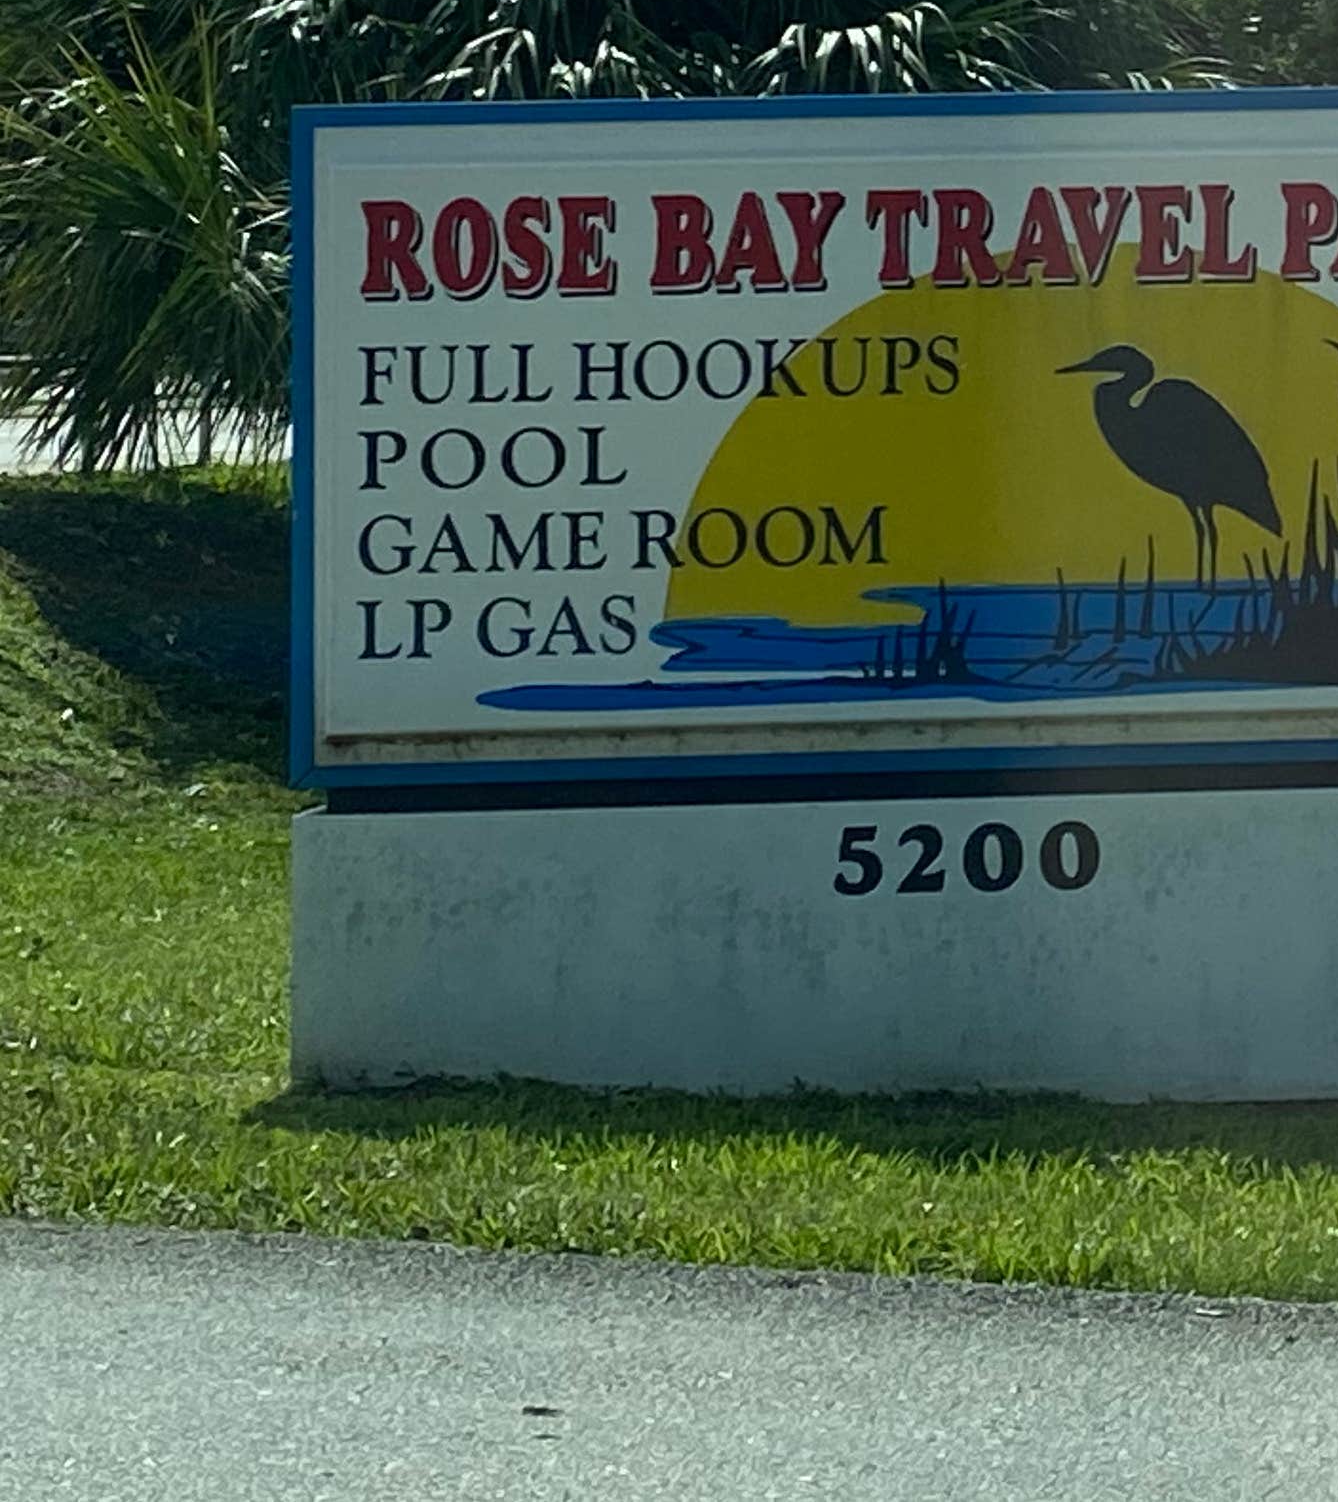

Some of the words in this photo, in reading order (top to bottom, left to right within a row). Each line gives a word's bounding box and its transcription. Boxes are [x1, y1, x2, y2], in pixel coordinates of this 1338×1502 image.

[360, 195, 616, 301] ROSE
[650, 191, 845, 296] BAY
[866, 184, 1257, 288] TRAVEL
[357, 343, 553, 406] FULL
[573, 334, 961, 400] HOOKUPS
[357, 426, 628, 491] POOL
[357, 510, 607, 575] GAME
[631, 505, 889, 570] ROOM
[356, 598, 452, 660] LP
[477, 594, 637, 657] GAS
[832, 819, 1102, 897] 5200
